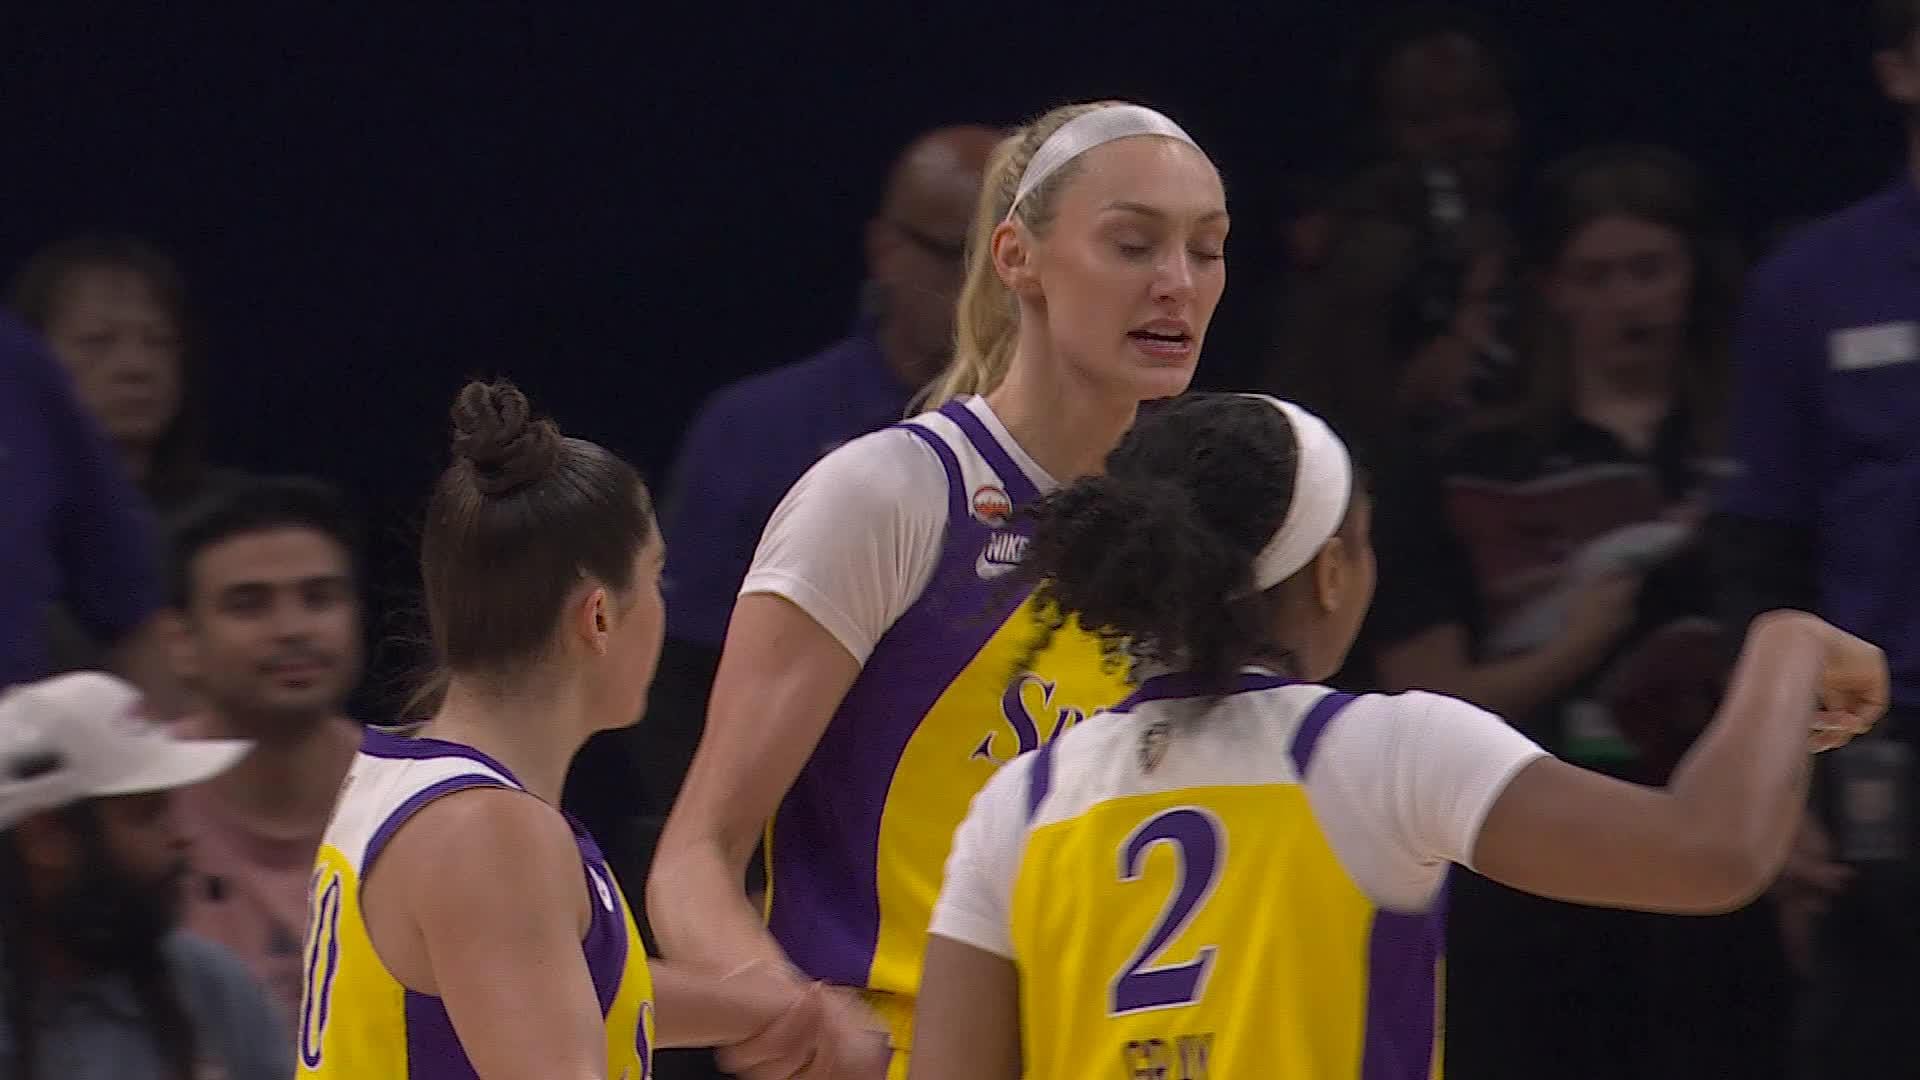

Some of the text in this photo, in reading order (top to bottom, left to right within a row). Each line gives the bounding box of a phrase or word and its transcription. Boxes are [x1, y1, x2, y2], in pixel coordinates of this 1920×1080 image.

[986, 531, 1031, 562] NIKE
[300, 862, 341, 1069] 0
[1107, 805, 1230, 1018] 2
